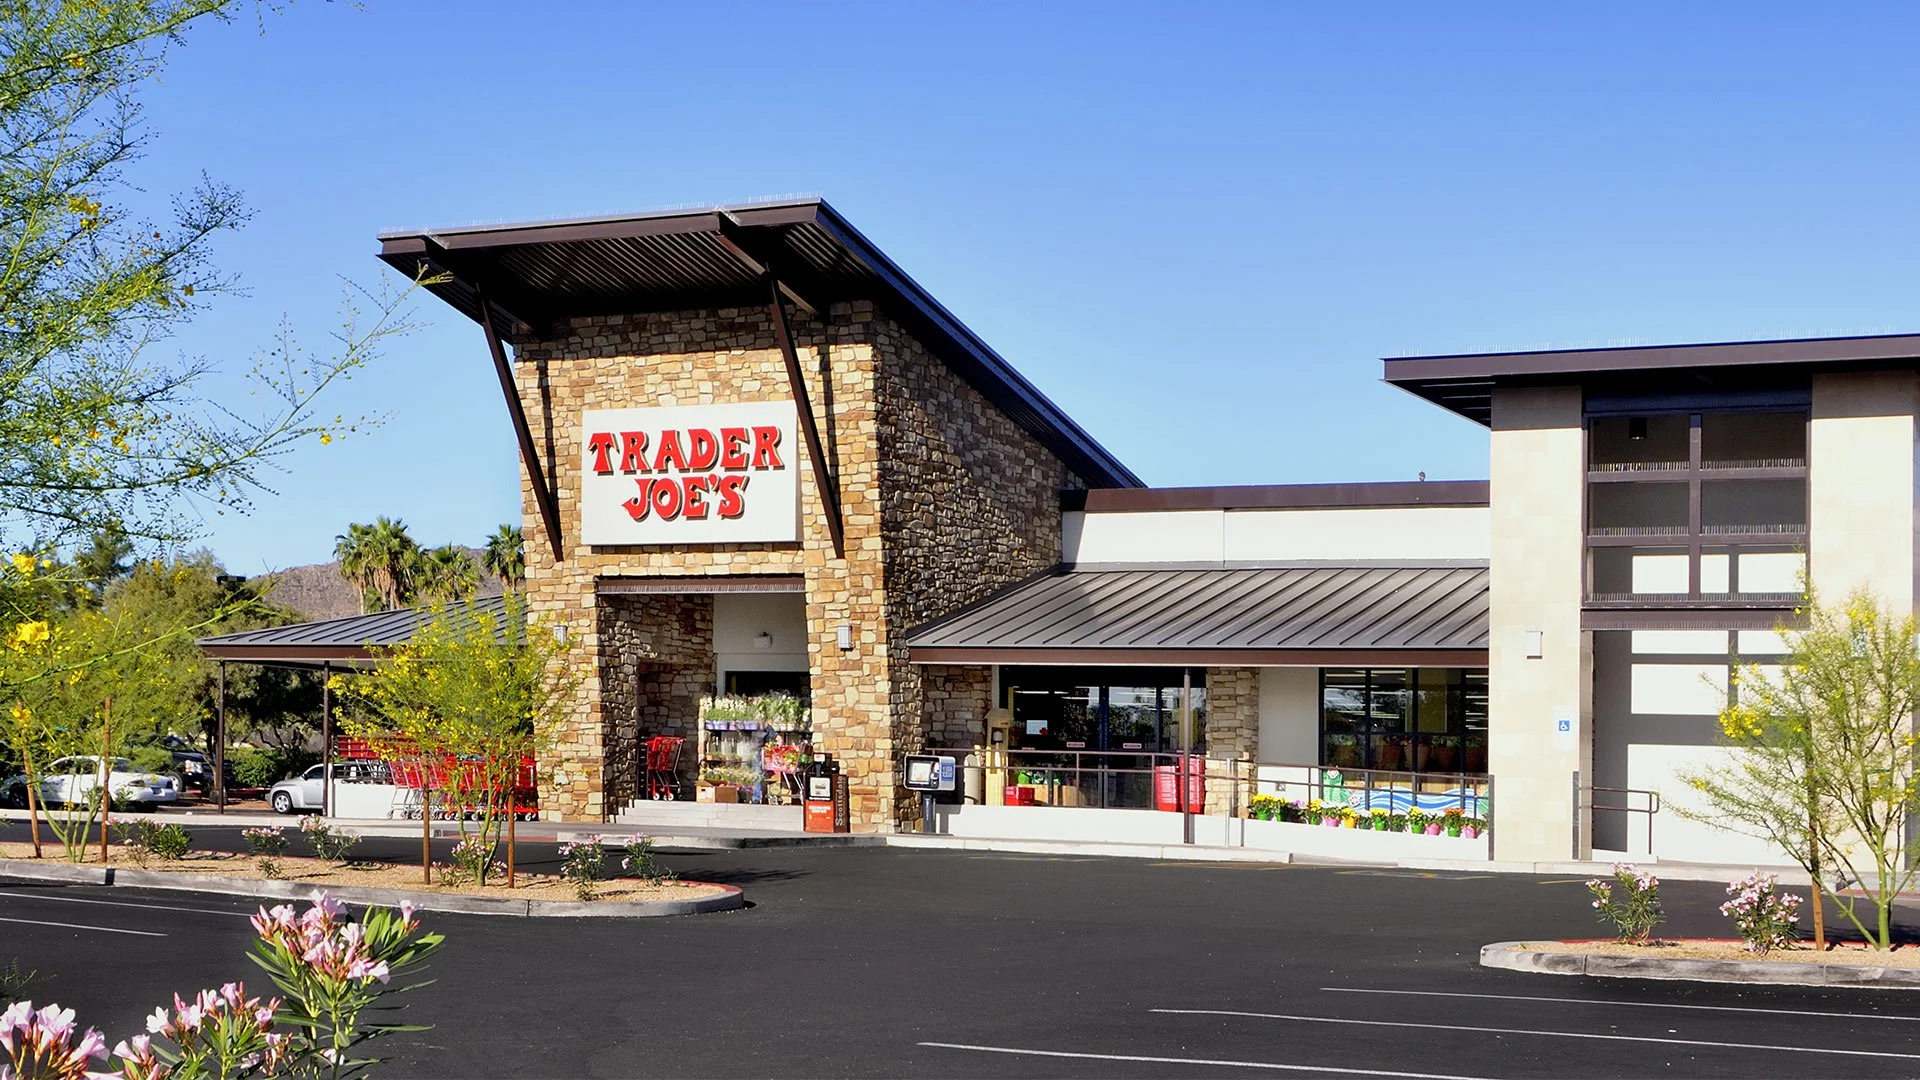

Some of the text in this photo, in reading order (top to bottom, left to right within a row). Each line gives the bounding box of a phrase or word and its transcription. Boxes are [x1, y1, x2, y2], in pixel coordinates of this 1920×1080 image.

[588, 426, 785, 474] TRADER
[622, 474, 749, 521] JOE'S
[835, 776, 844, 827] Scottsdale
